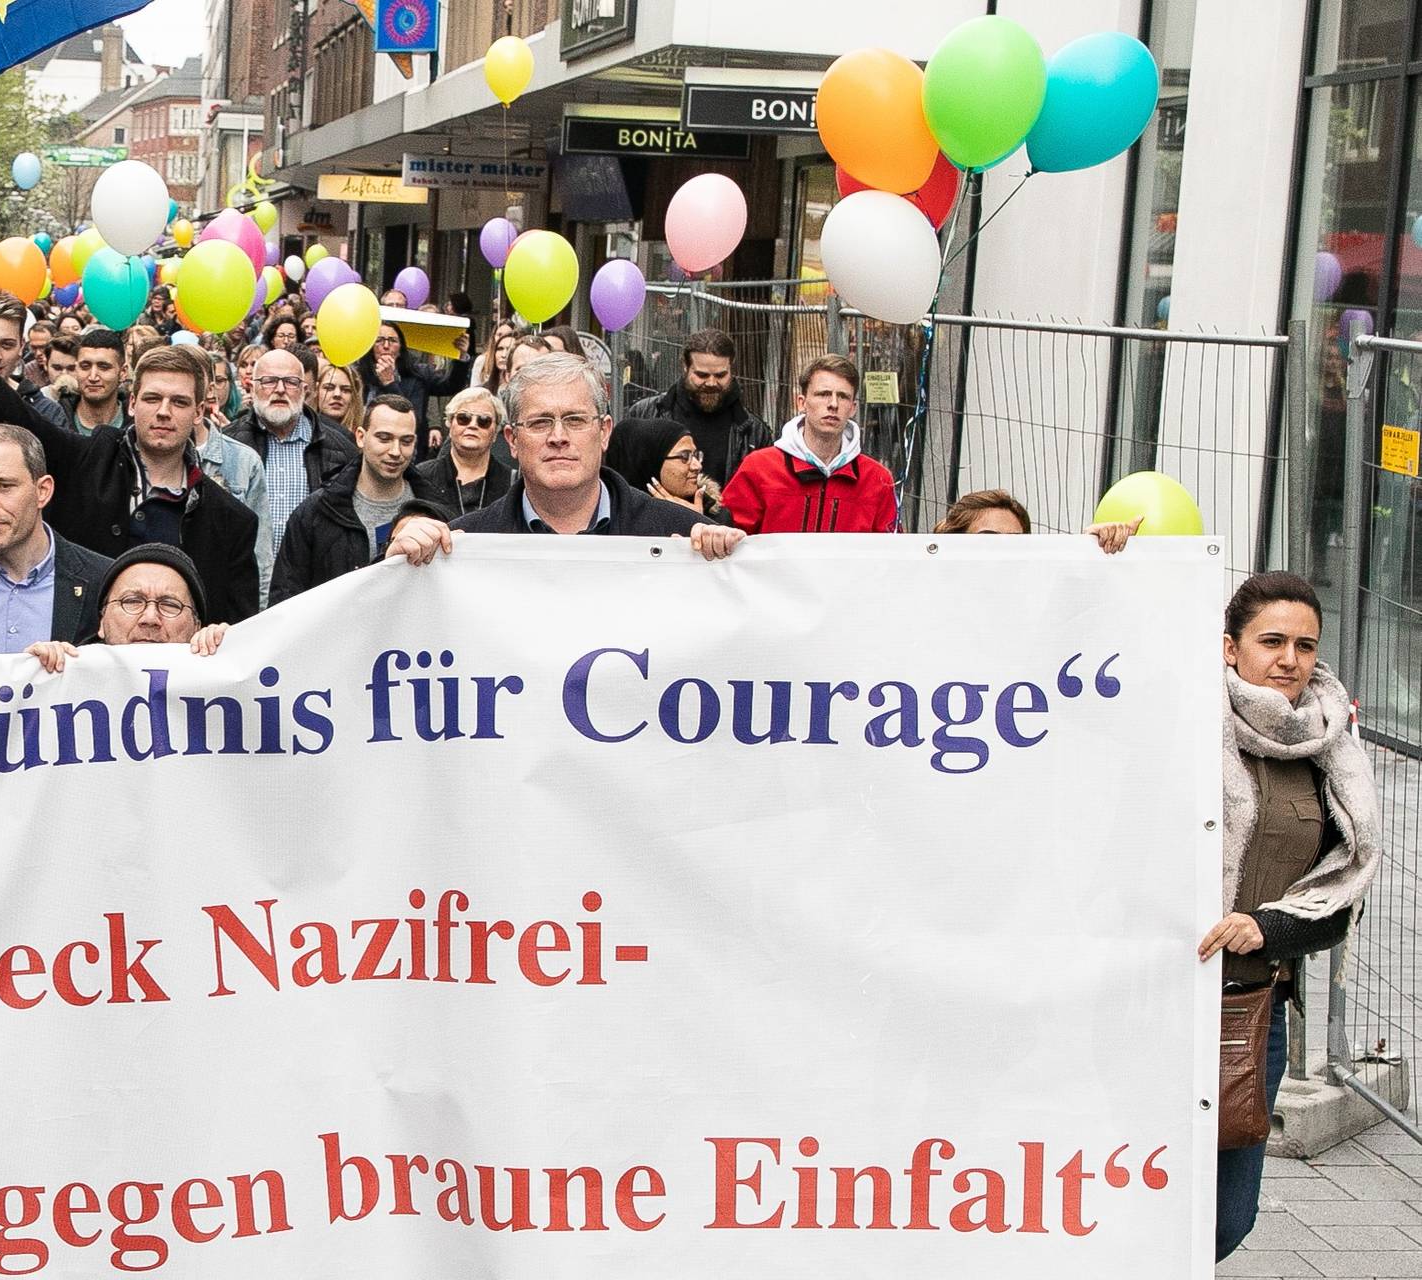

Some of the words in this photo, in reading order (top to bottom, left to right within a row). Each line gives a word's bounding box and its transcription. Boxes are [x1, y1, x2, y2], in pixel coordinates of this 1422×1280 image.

[340, 176, 393, 196] Auftritt
[410, 159, 475, 174] mister
[480, 161, 546, 177] maker
[303, 206, 332, 224] dm
[365, 649, 524, 744] für
[561, 647, 1121, 774] Courage“
[201, 888, 648, 997] Nazifrei-
[318, 1131, 667, 1232] braune
[702, 1136, 1169, 1237] Einfalt“
